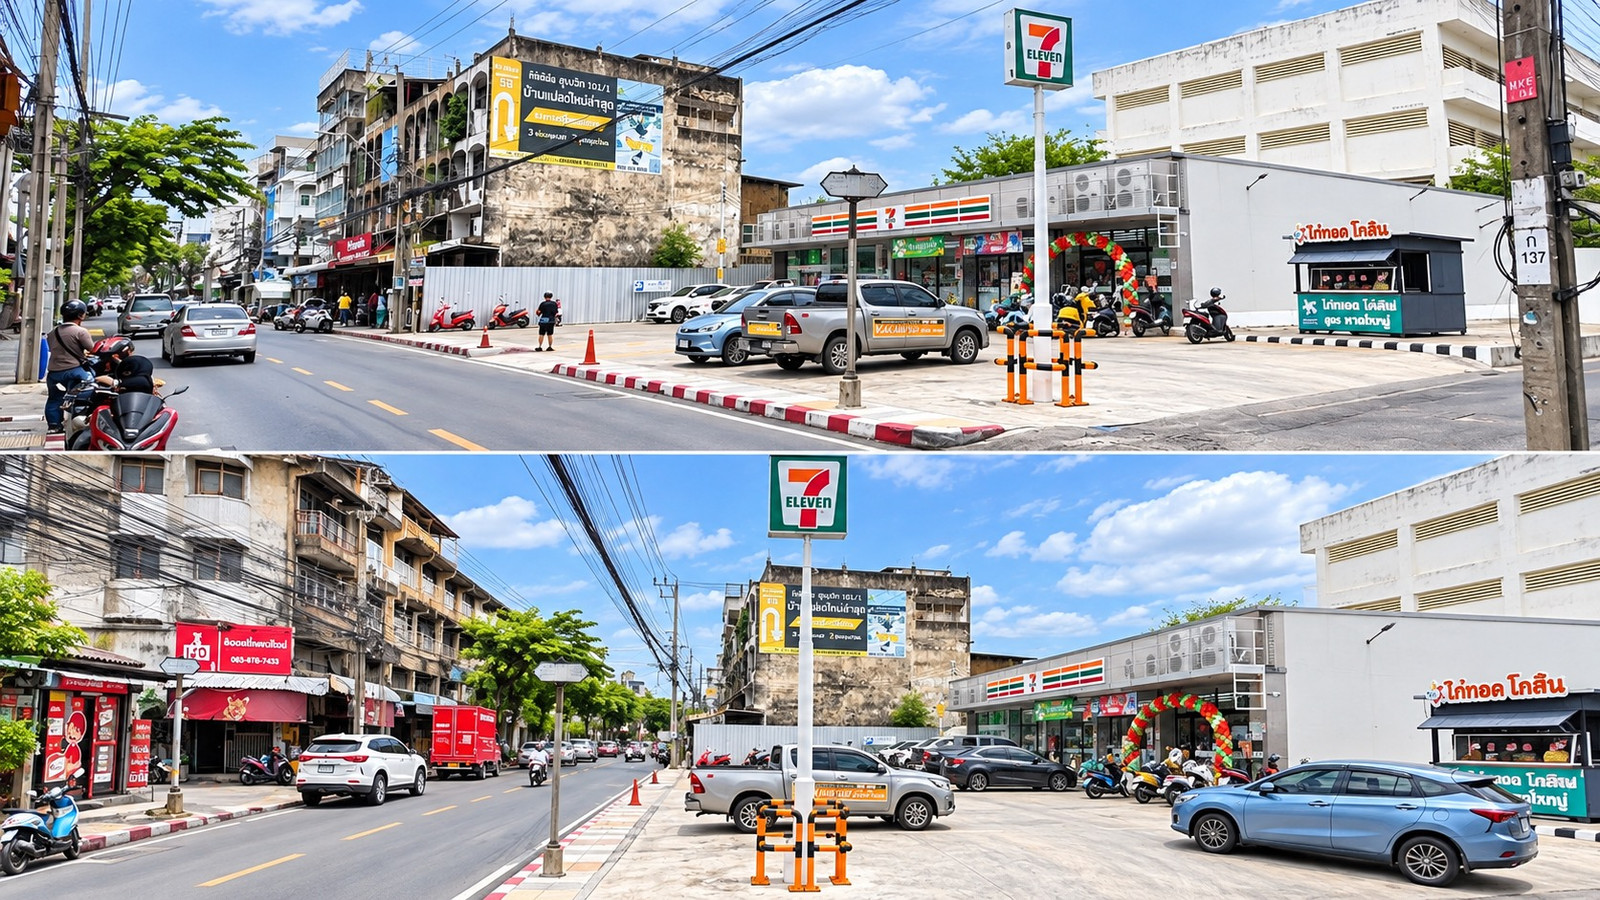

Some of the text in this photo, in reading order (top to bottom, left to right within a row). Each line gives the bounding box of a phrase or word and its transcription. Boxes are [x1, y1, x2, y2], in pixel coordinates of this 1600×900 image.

[1521, 251, 1546, 264] 137
[1443, 679, 1505, 700] ไก่ทอด
